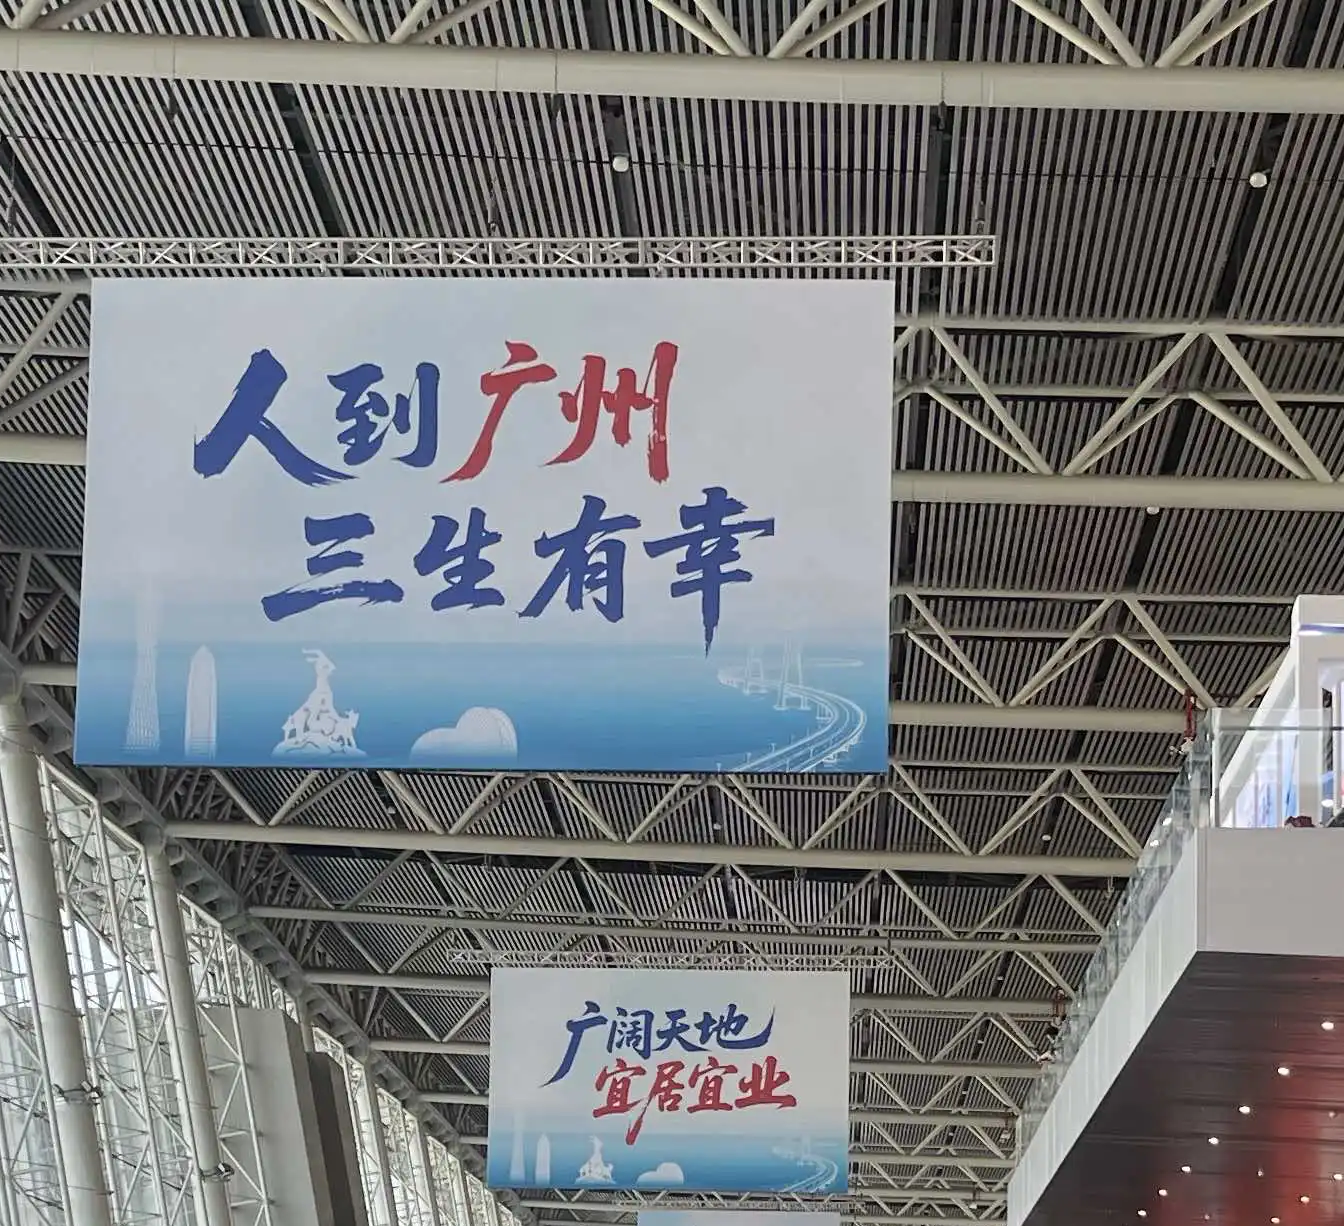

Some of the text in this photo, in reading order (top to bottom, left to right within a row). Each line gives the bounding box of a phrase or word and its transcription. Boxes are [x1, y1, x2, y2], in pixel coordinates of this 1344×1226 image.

[193, 340, 679, 486] 人到广州
[261, 486, 775, 657] 三生有幸
[541, 1001, 776, 1088] 广阔天地
[592, 1055, 797, 1145] 宜居宜业
